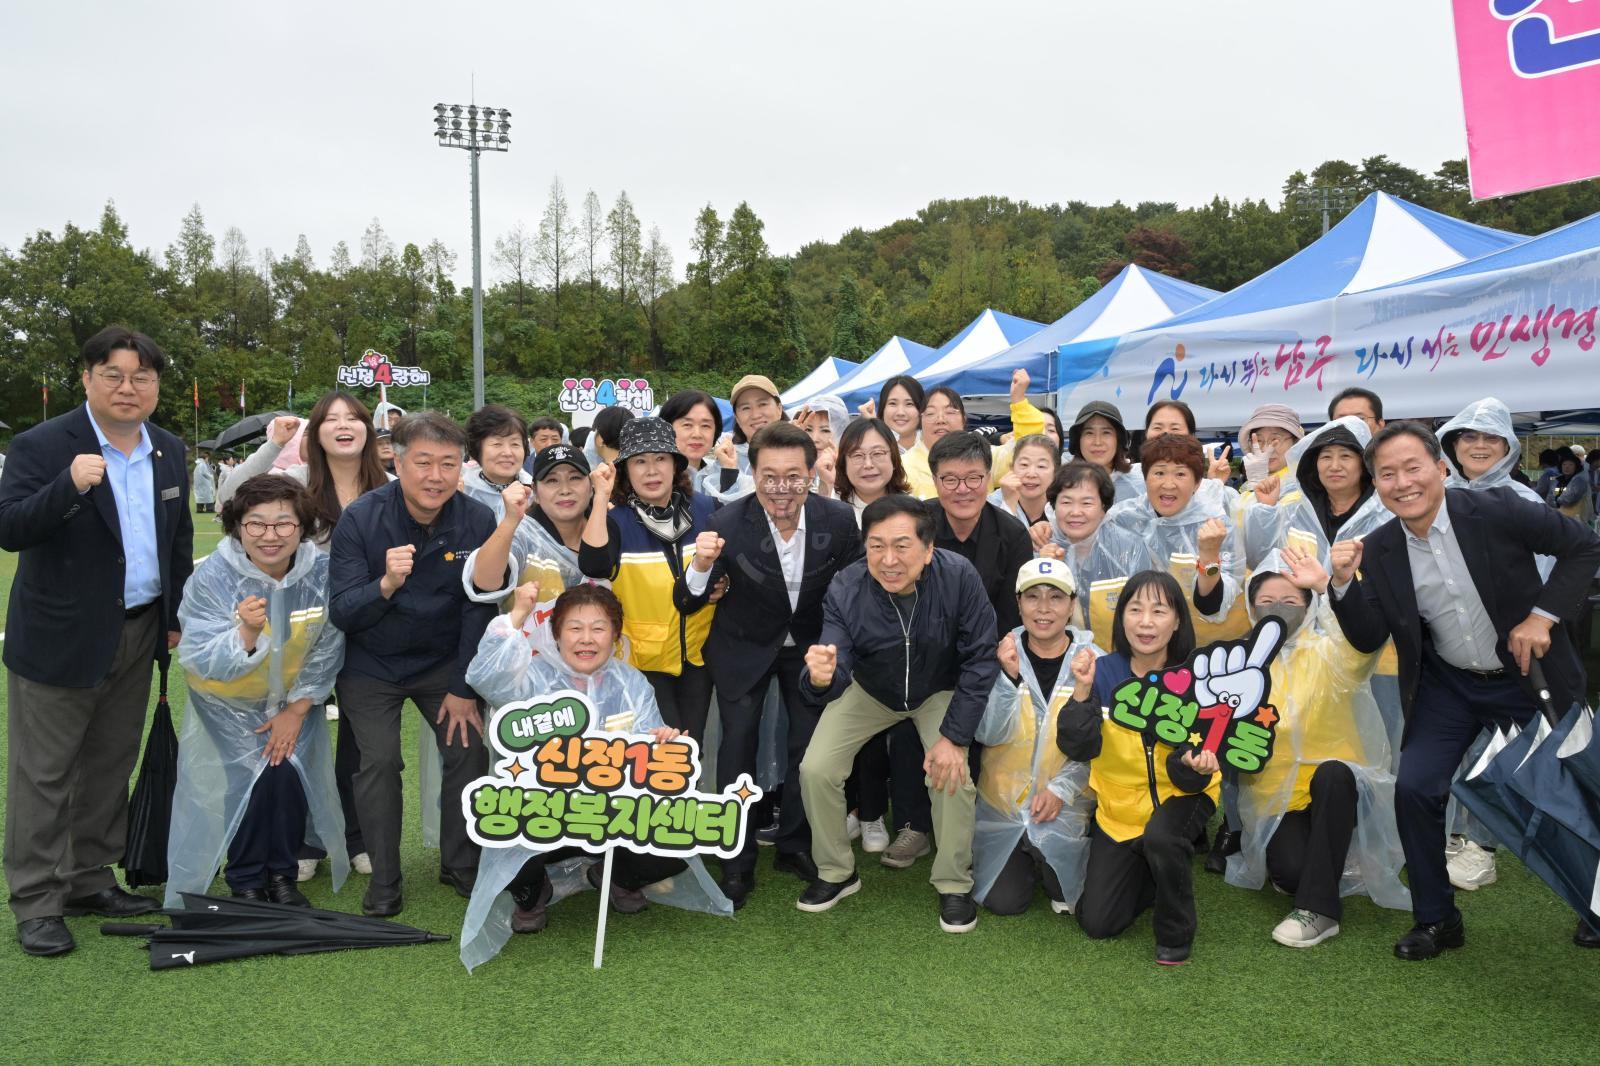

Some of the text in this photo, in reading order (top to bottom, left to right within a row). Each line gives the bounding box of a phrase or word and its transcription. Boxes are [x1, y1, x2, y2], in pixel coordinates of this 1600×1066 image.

[1200, 360, 1237, 393] 다시
[1240, 351, 1271, 393] 뛰는
[1274, 335, 1339, 392] 남구
[1355, 336, 1415, 380] 다시
[1038, 561, 1053, 575] C
[510, 705, 577, 739] 내곁에
[1113, 680, 1272, 771] 신정1동
[536, 736, 692, 792] 신정1동
[474, 785, 739, 847] 행정복지센터
